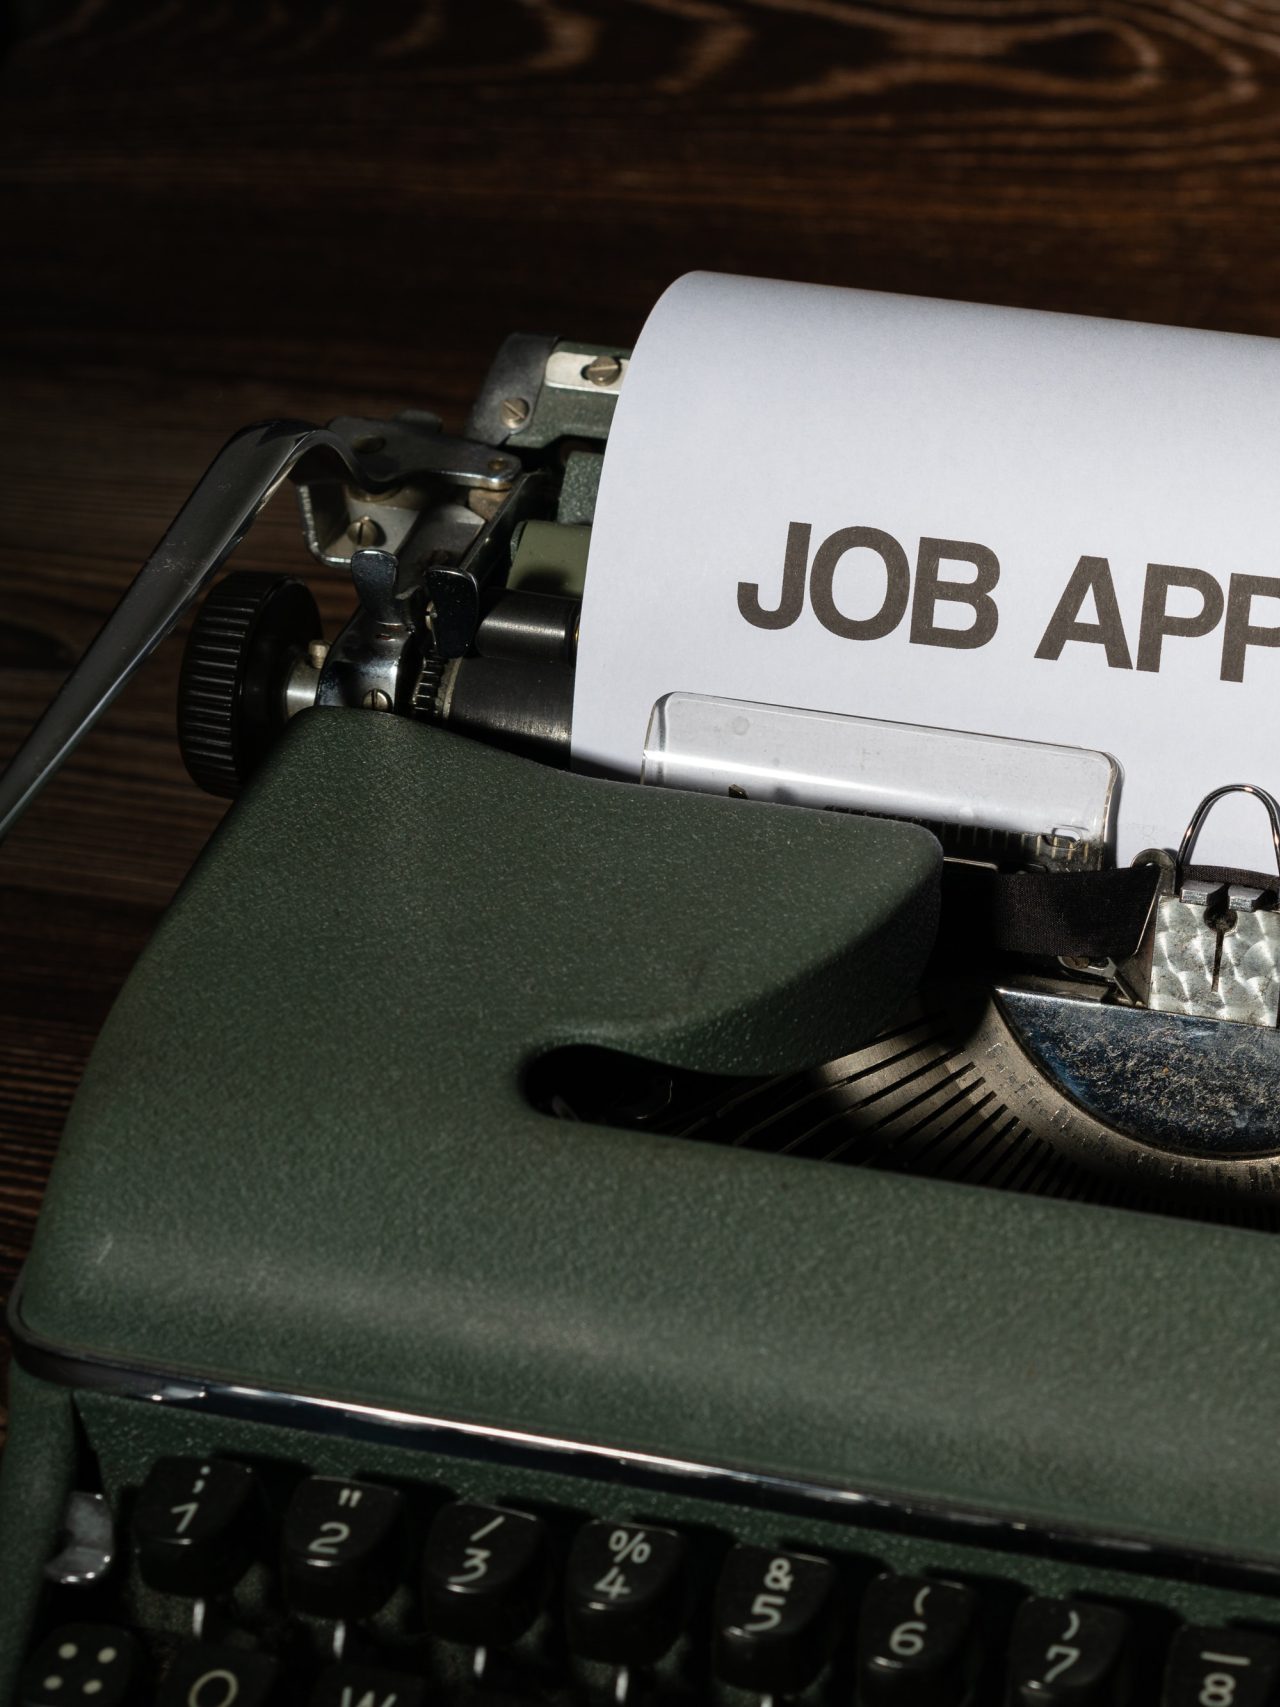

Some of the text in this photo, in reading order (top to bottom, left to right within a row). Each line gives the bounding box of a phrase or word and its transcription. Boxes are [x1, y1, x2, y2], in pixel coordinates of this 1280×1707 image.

[737, 521, 1001, 650] JOB
[169, 1500, 200, 1535] 1
[469, 1514, 507, 1543] /
[307, 1520, 352, 1555] 2
[607, 1529, 653, 1566] %
[447, 1546, 493, 1584] 3
[592, 1564, 633, 1600] 4
[763, 1556, 796, 1592] &
[744, 1594, 787, 1632] 5
[913, 1585, 932, 1618] (
[888, 1620, 929, 1658] 6
[1060, 1609, 1082, 1643] )
[1044, 1644, 1083, 1684] 7
[1197, 1671, 1238, 1707] 8
